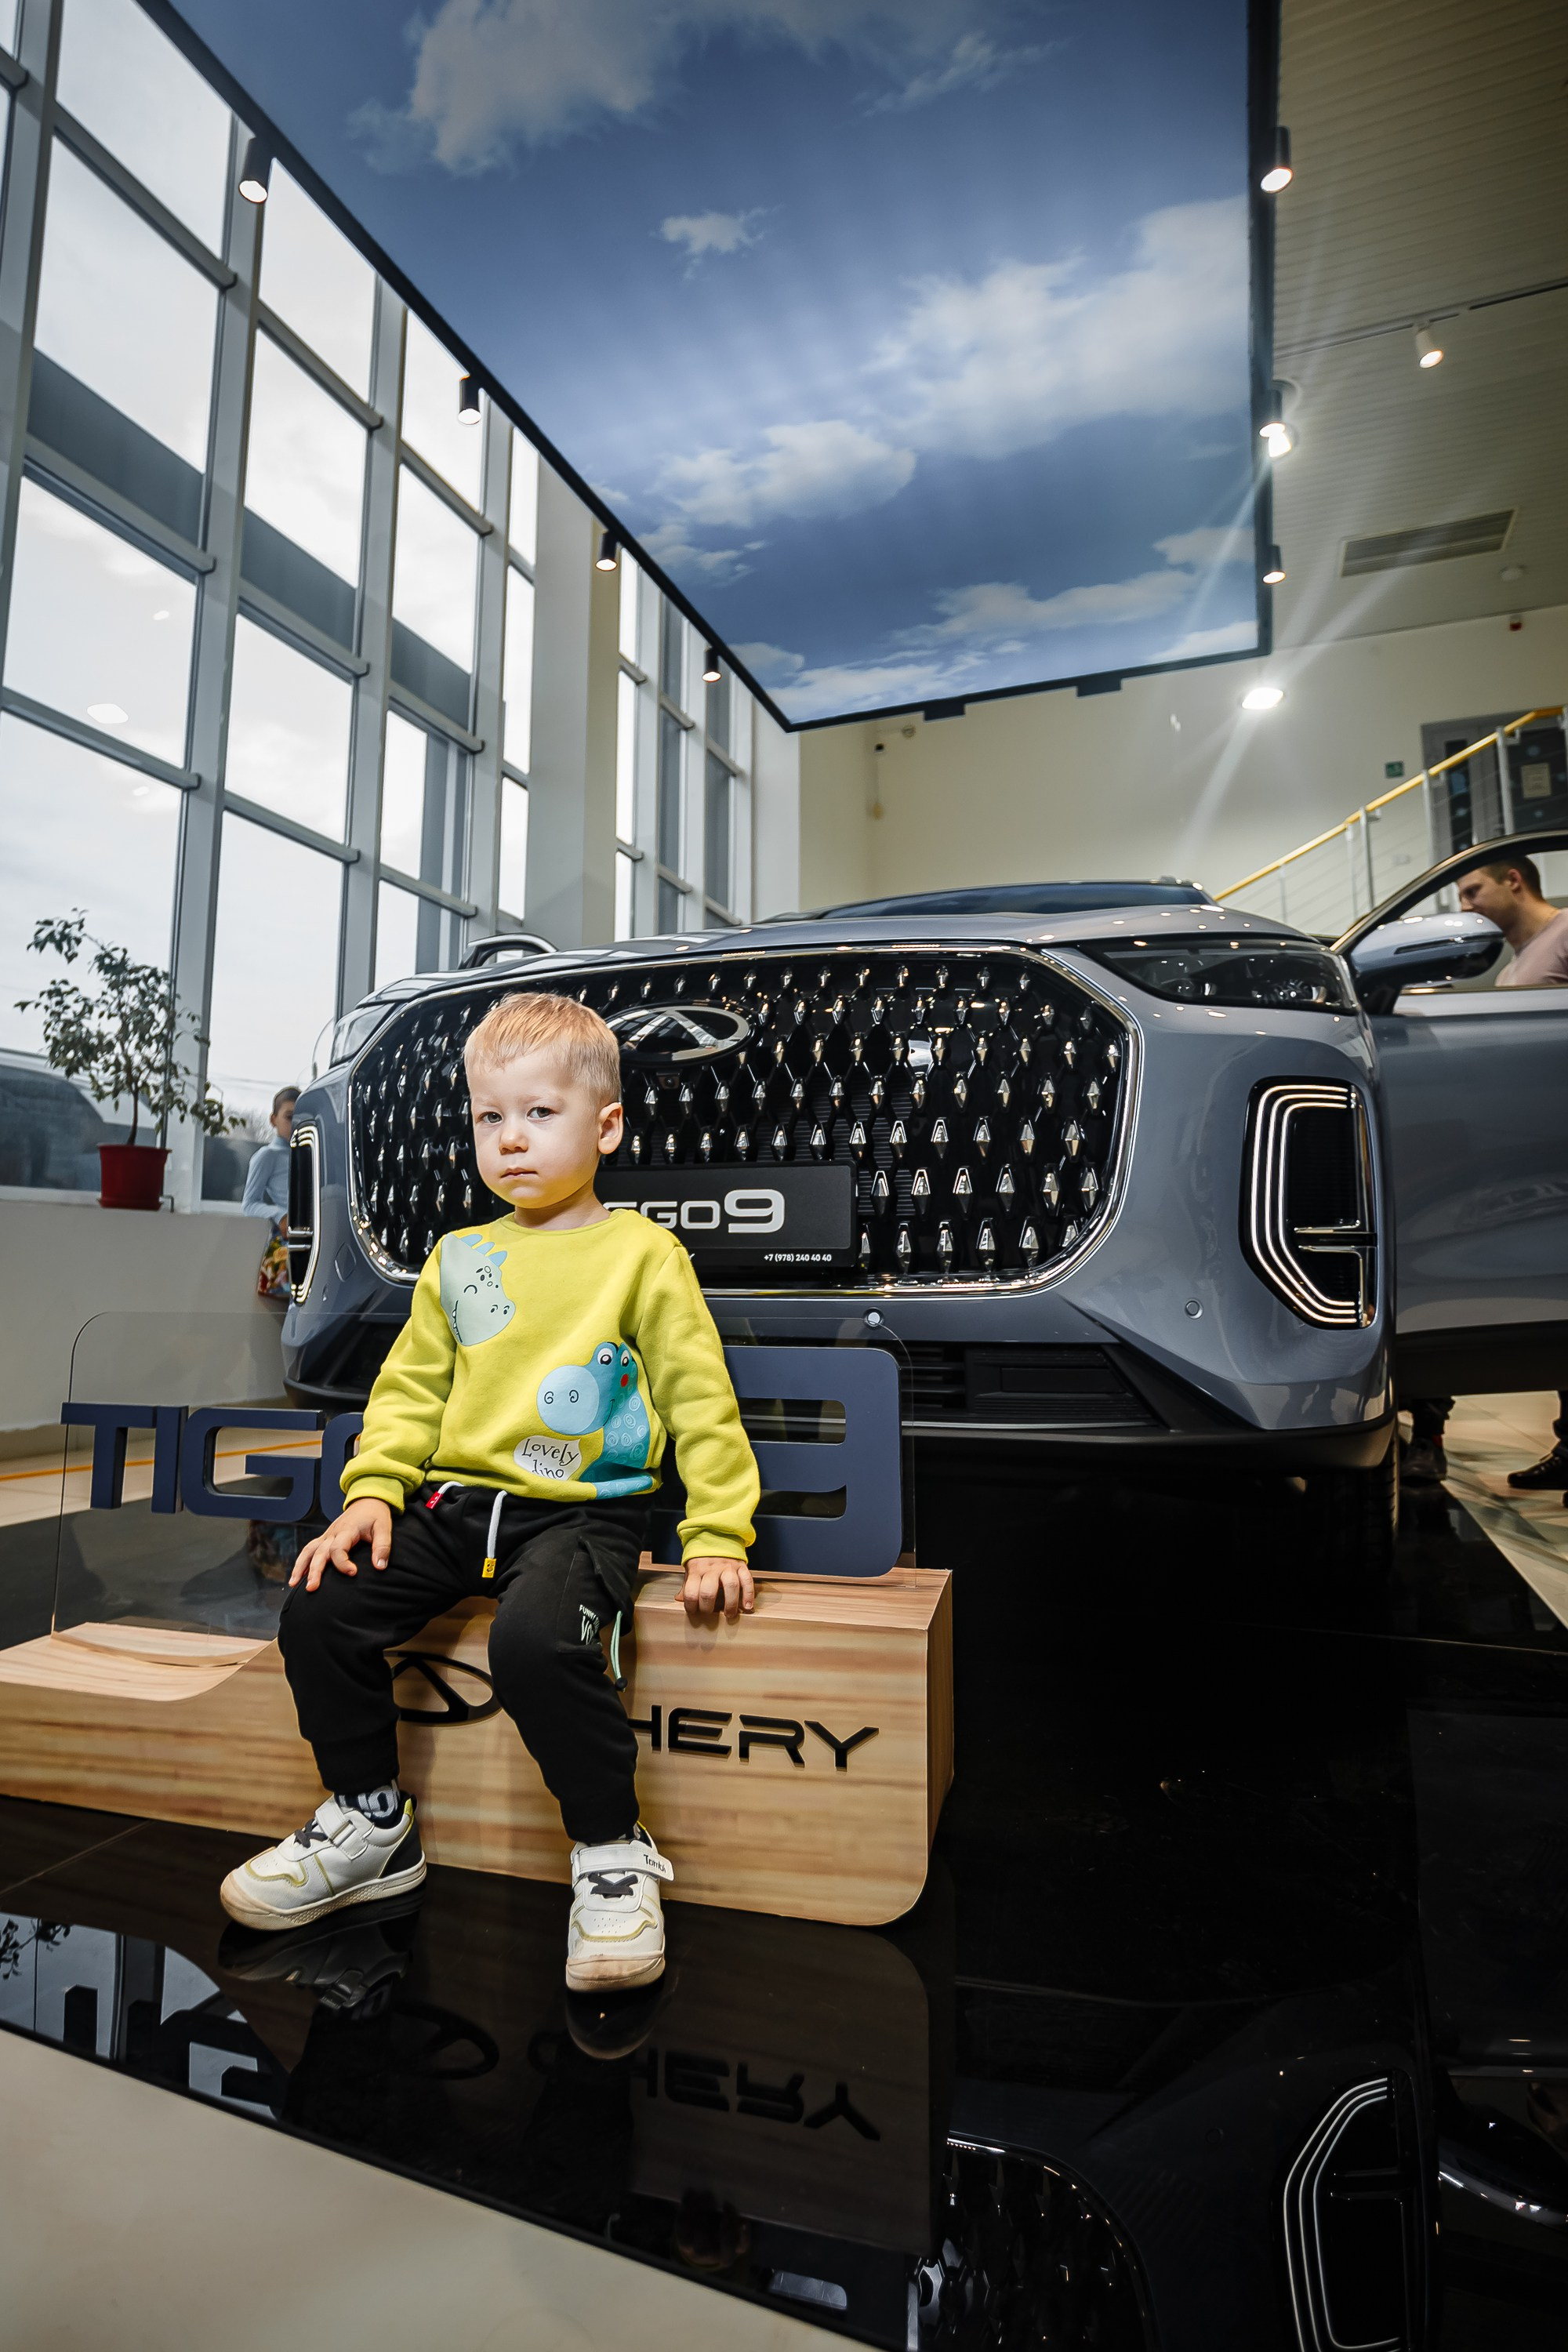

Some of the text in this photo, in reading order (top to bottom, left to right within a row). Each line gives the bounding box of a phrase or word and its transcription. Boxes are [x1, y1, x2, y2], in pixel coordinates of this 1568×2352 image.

[775, 1253, 794, 1262] (978)
[60, 1402, 365, 1523] TIG
[521, 1438, 579, 1467] Lovely
[626, 1704, 880, 1769] HERY
